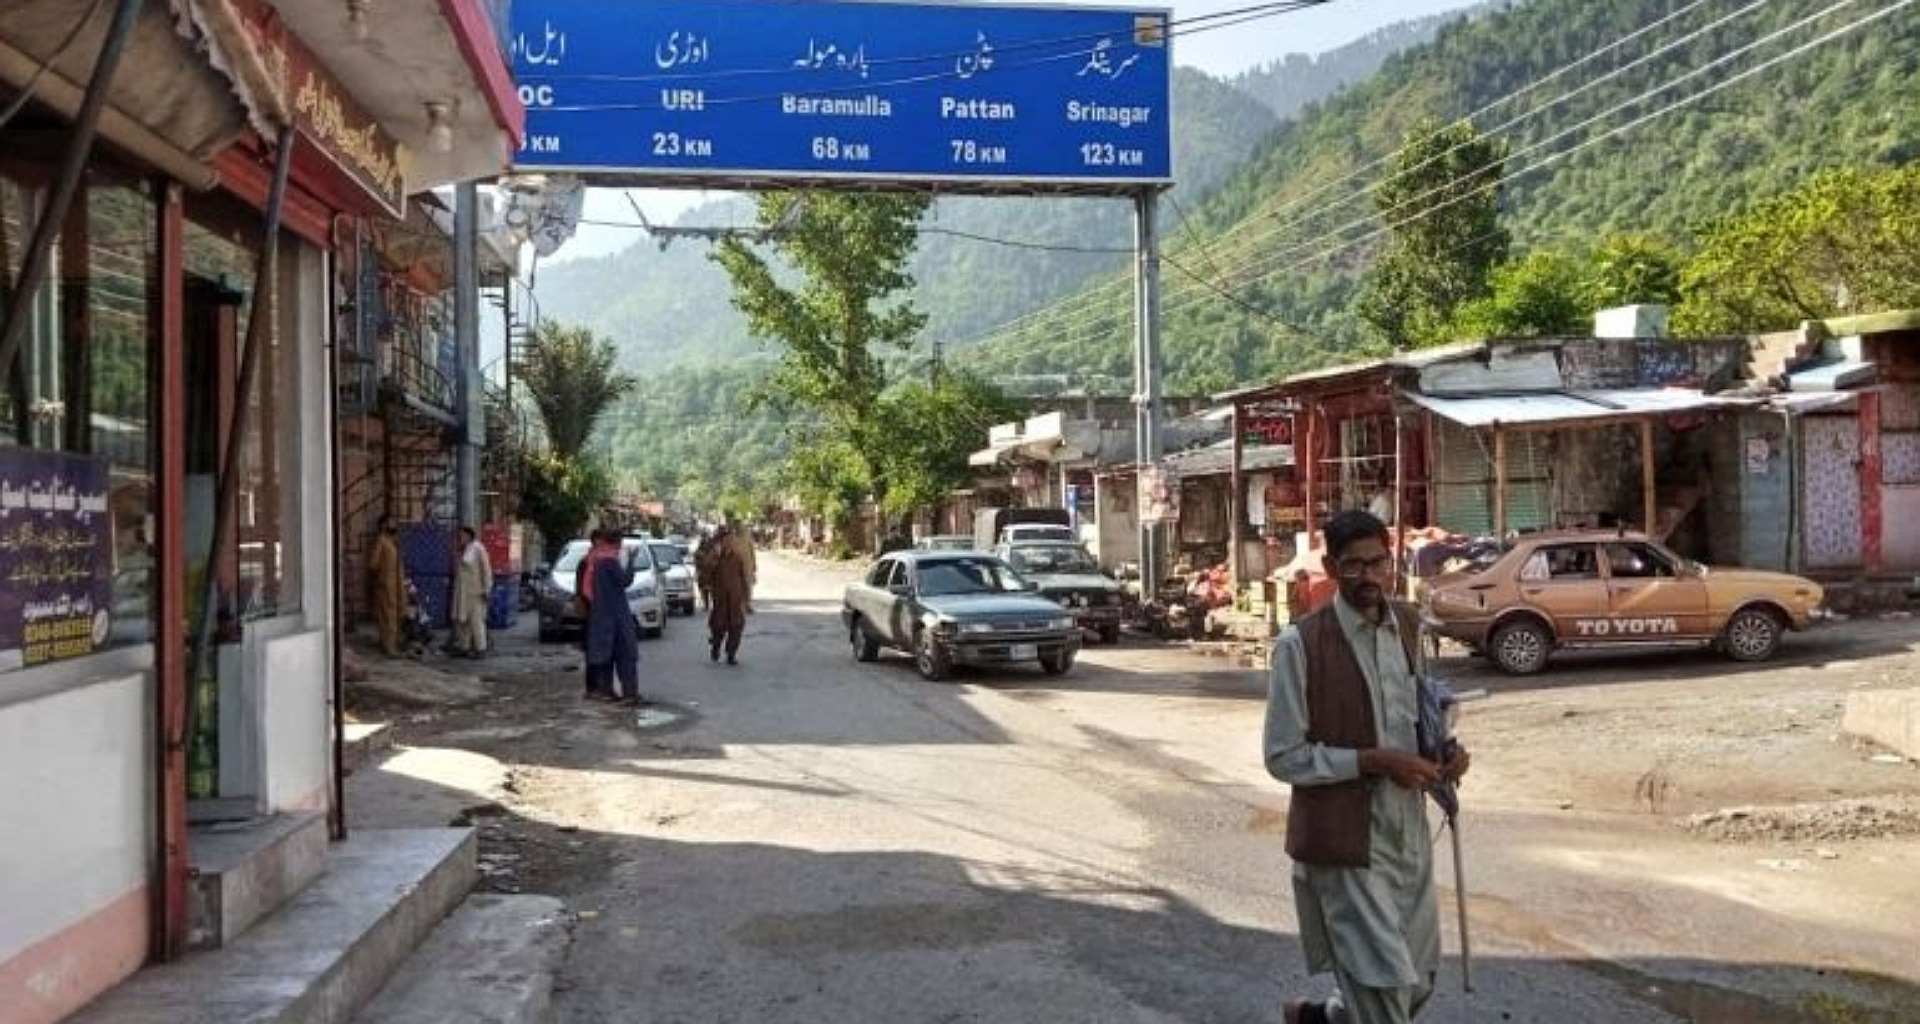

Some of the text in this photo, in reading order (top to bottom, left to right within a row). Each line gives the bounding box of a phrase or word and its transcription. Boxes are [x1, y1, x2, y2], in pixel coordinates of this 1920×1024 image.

[655, 29, 707, 69] اوڑی
[518, 85, 554, 107] OC
[662, 89, 704, 111] URI
[782, 94, 892, 117] Baramulla
[941, 96, 1015, 119] Pattan
[1066, 100, 1150, 128] Srinagar
[530, 135, 560, 152] KM
[653, 132, 712, 157] 23 KM
[812, 136, 870, 161] 68 KM
[951, 139, 1006, 164] 78 KM
[1081, 143, 1144, 166] 123 KM
[1576, 617, 1680, 635] TOYOTA
